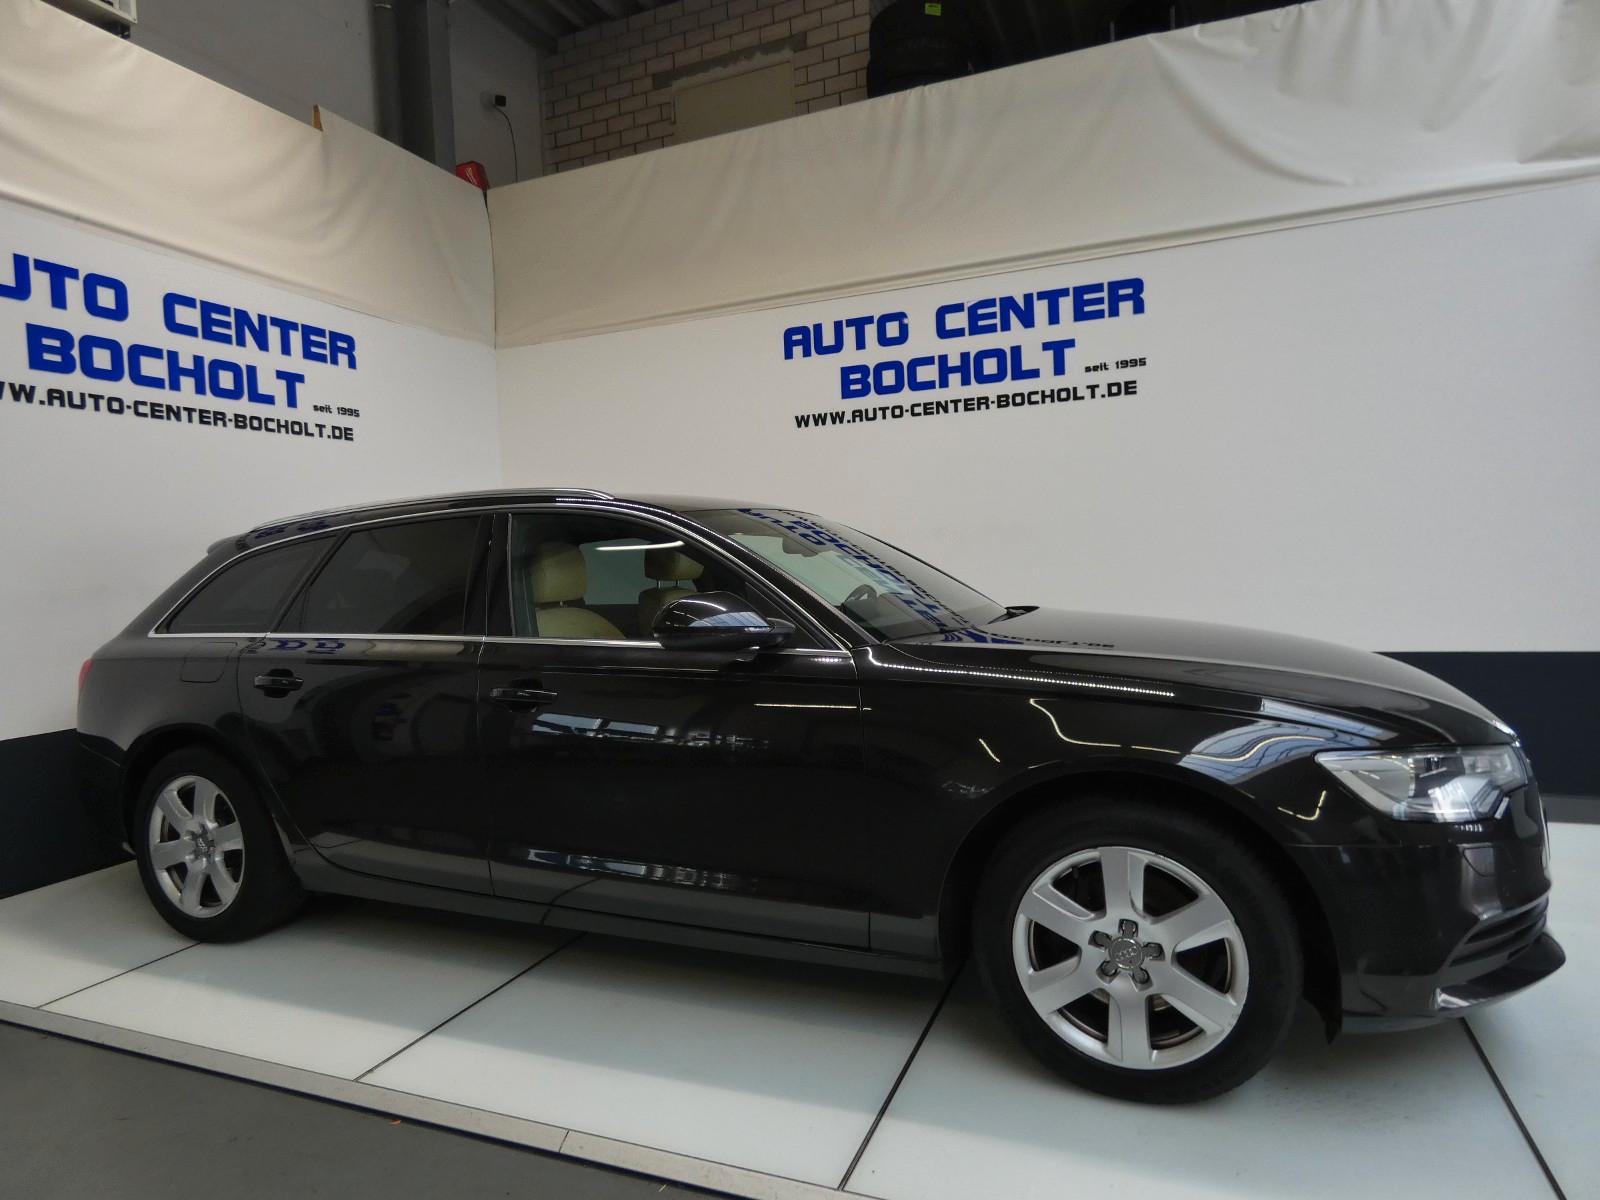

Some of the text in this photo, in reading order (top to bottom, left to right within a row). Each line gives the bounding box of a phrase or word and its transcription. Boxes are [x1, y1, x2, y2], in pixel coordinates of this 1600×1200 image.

[163, 292, 357, 369] CENTER
[783, 277, 1145, 360] AUTO CENTER
[25, 322, 305, 409] BOCHOLT
[840, 338, 1076, 400] BOCHOLT
[1085, 357, 1147, 373] seit 1995
[0, 380, 354, 442] W.AUTO-CENTER-BOCHOLT.DE
[312, 404, 360, 418] seit 1995
[794, 379, 1138, 429] WWW.AUTO-CENTER-BOCHOLT.DE
